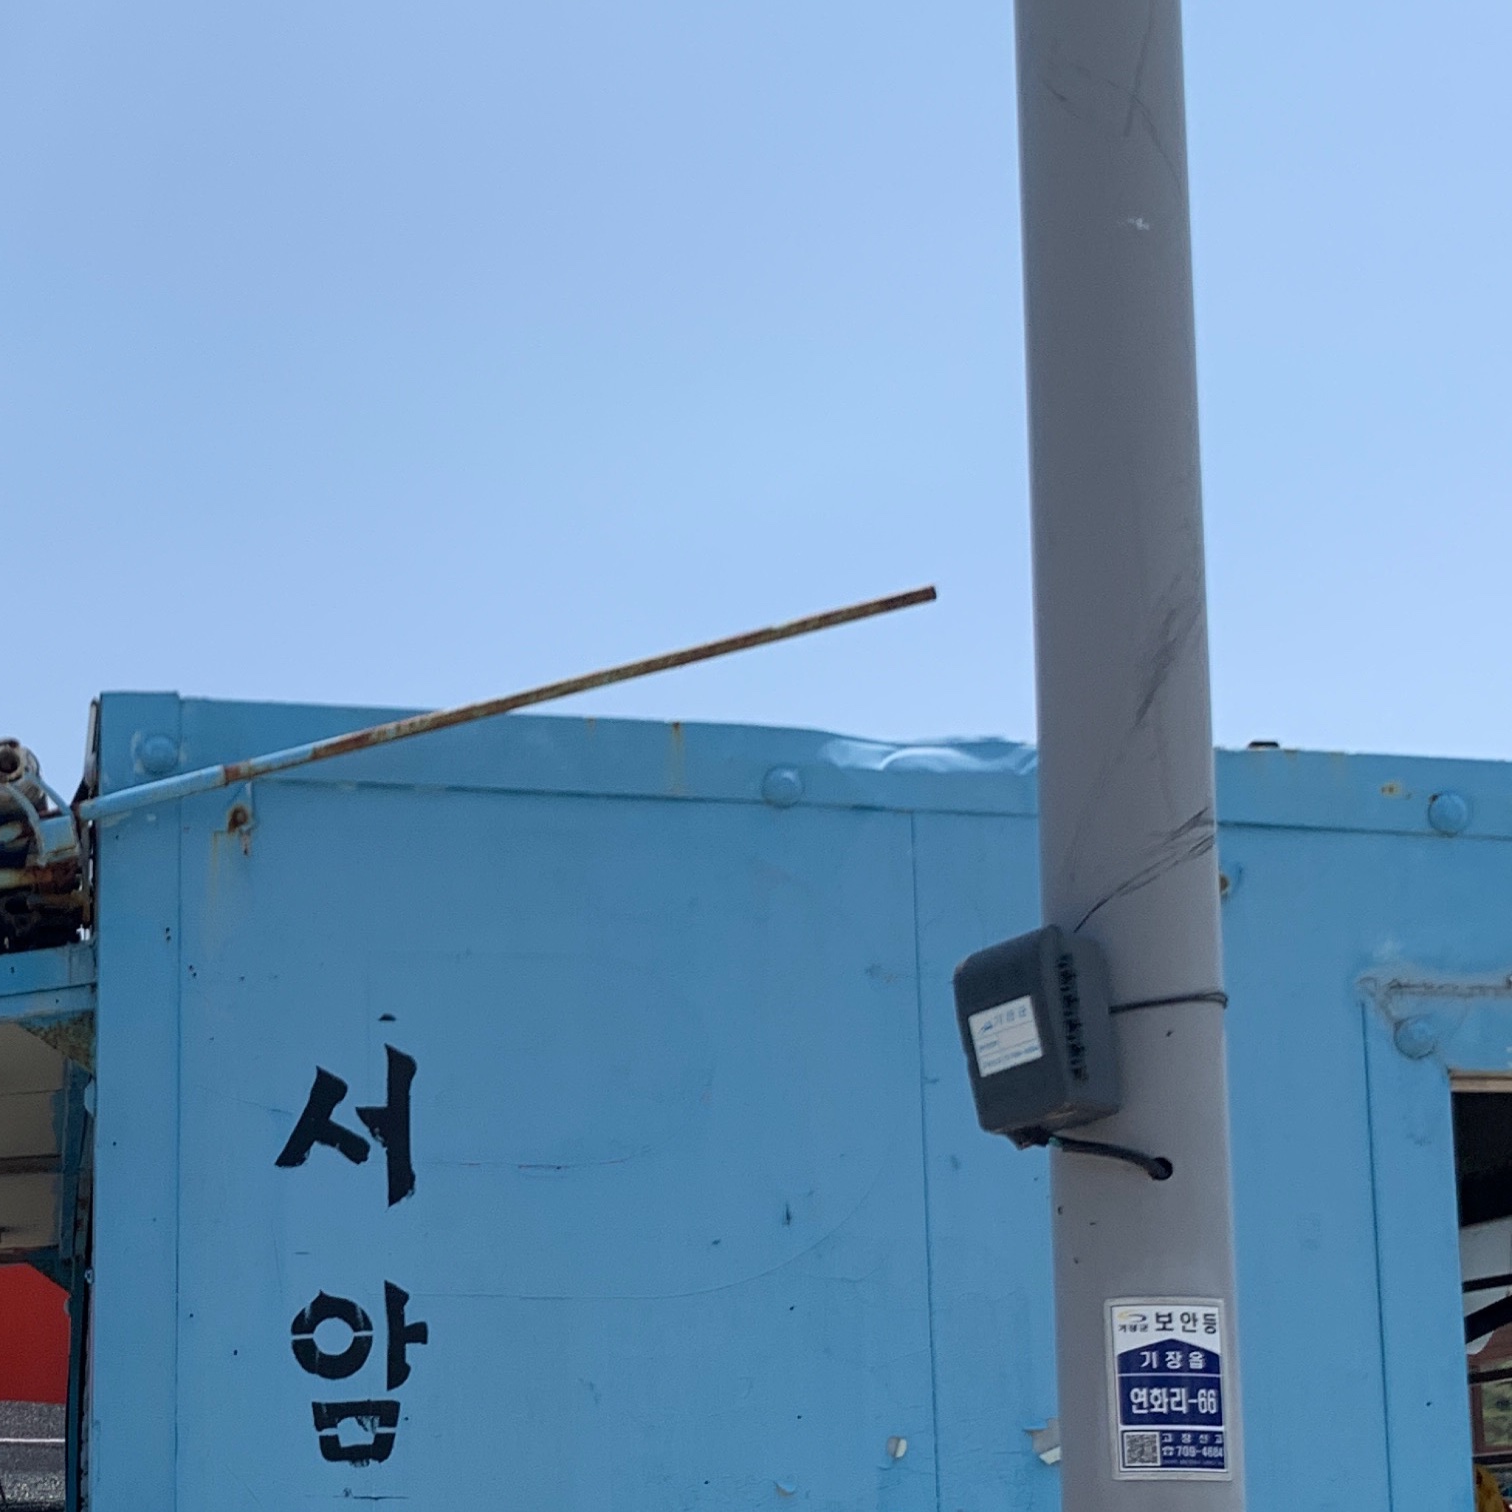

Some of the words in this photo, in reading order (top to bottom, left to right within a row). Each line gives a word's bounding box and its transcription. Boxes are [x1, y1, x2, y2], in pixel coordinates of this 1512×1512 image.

[1154, 1312, 1217, 1335] 보안등
[1140, 1351, 1206, 1370] 기장읍
[1129, 1387, 1217, 1415] 연화리-66
